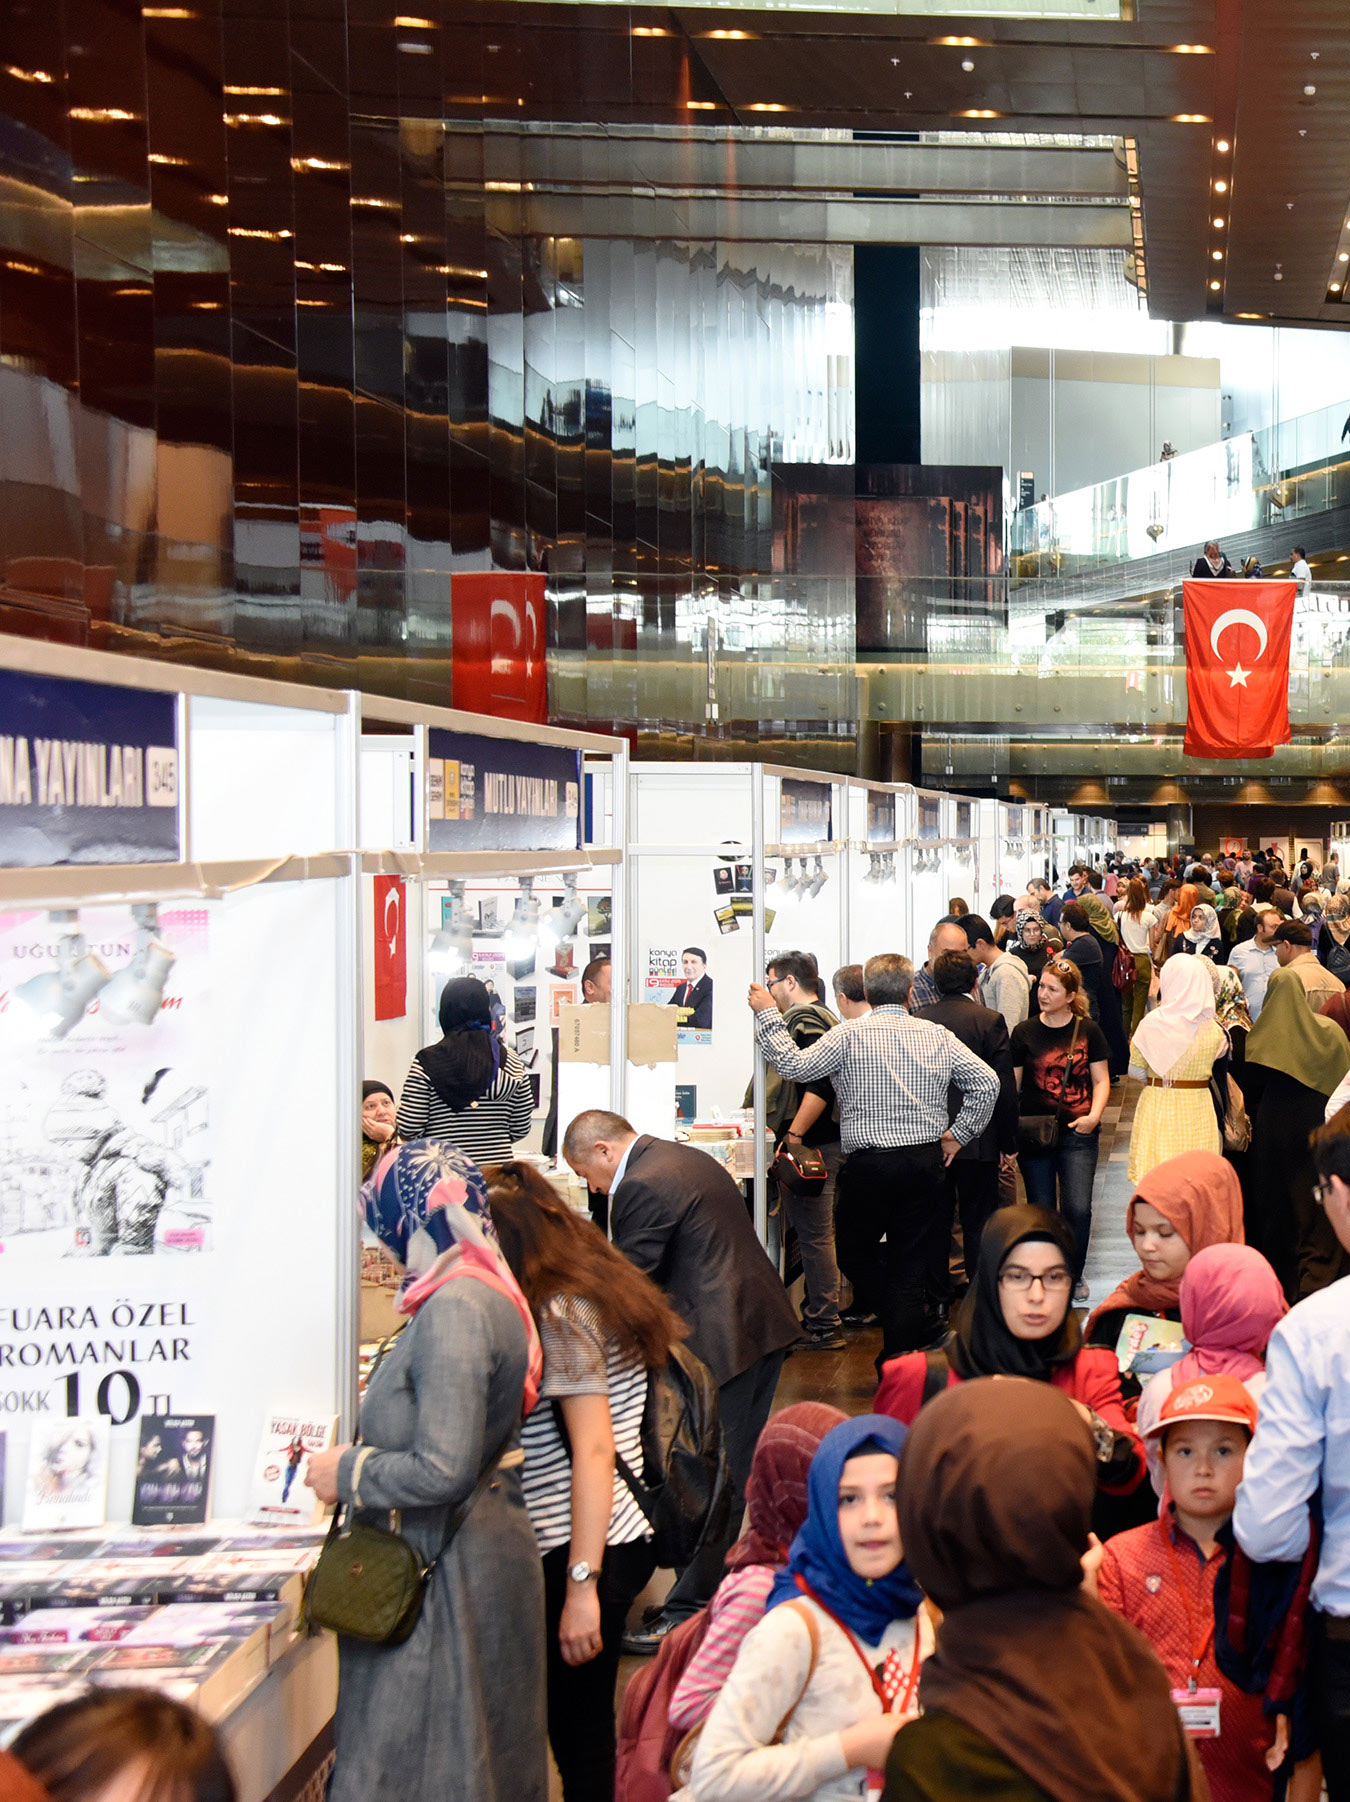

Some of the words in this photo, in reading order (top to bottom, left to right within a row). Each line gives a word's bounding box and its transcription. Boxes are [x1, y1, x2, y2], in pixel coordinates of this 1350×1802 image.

[34, 736, 143, 808] YAYINLARI
[484, 772, 515, 814] MUTLU
[515, 775, 558, 817] YAYINLARI
[648, 948, 678, 958] konya
[648, 956, 678, 967] kitap
[111, 1298, 197, 1328] ÖZEL
[0, 1337, 192, 1367] ROMANLAR
[54, 1369, 141, 1426] 10
[271, 1420, 298, 1435] YASAK
[300, 1422, 327, 1438] BÖLGE
